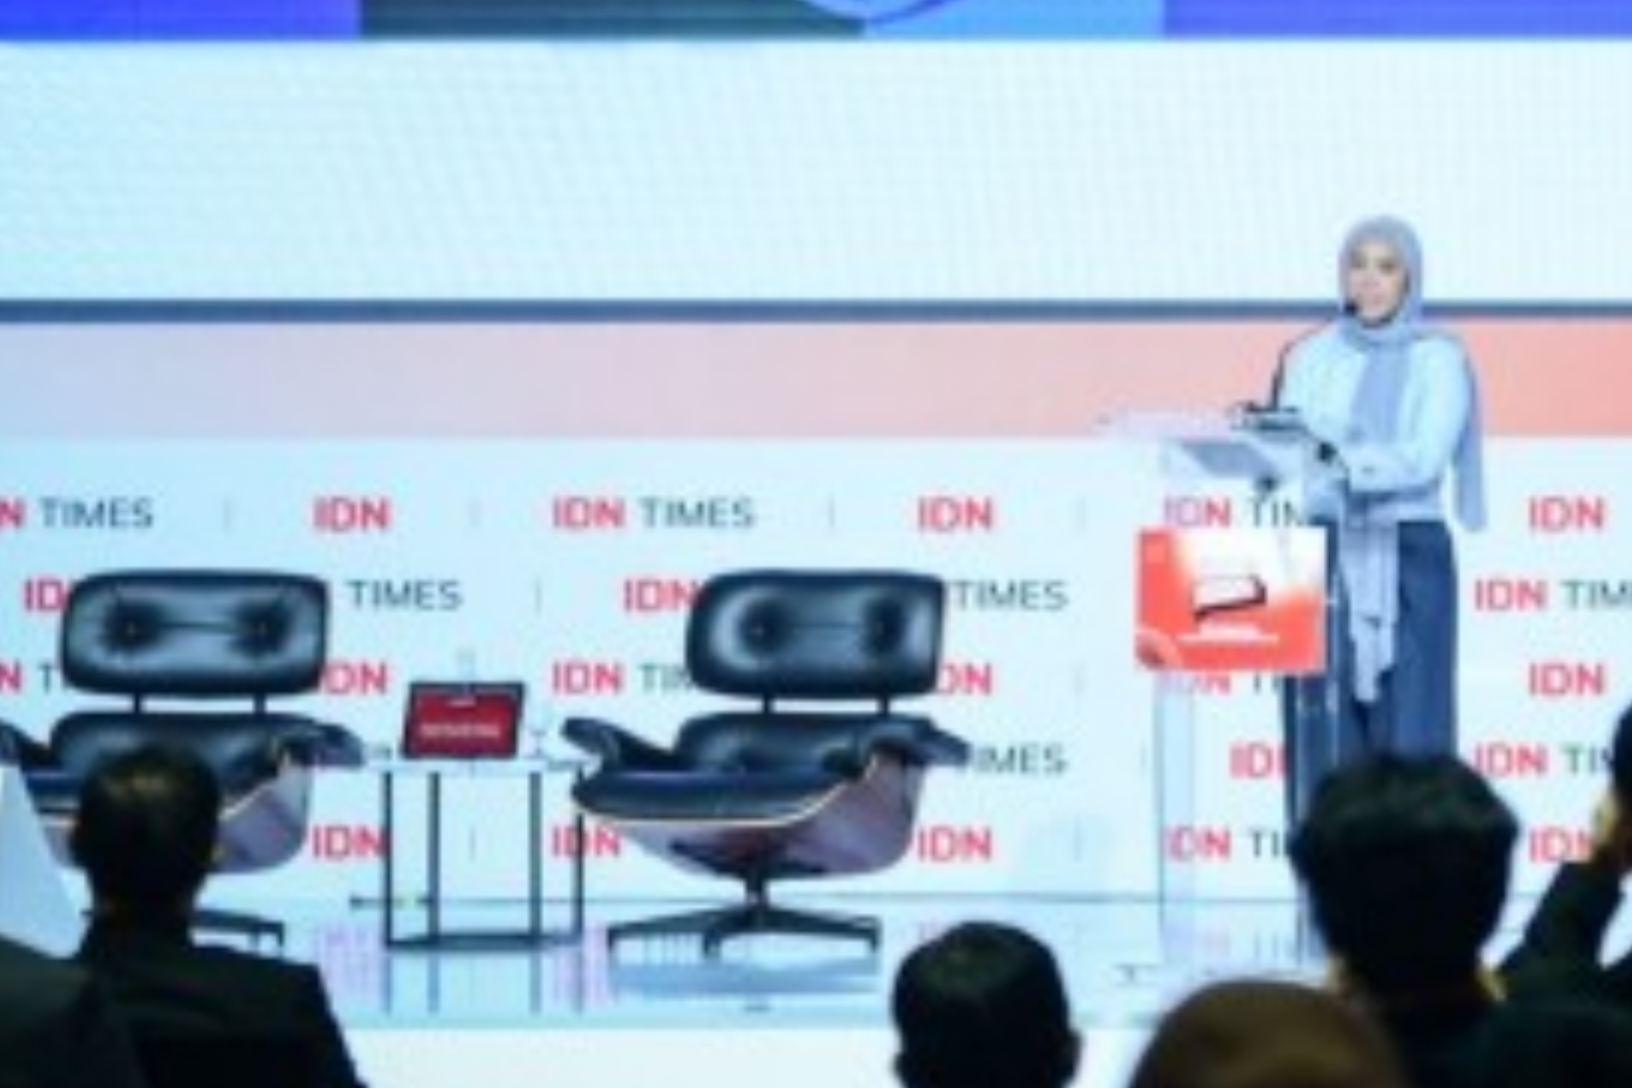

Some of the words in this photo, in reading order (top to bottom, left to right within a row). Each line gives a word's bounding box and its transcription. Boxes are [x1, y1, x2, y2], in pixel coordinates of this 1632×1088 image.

[41, 497, 154, 528] TIMES
[313, 497, 389, 529] IDN
[553, 496, 624, 529] IDN
[640, 497, 753, 528] TIMES
[918, 497, 993, 529] IDN
[1529, 496, 1604, 529] IDN
[25, 579, 68, 611] ID
[349, 580, 462, 610] TIMES
[951, 579, 1068, 610] TIMES
[1476, 578, 1548, 611] IDN
[325, 662, 387, 694] DN
[553, 663, 622, 695] IDN
[1529, 663, 1604, 695] IDN
[1476, 743, 1548, 777] IDN
[313, 826, 390, 858] IDN
[918, 826, 993, 860] IDN
